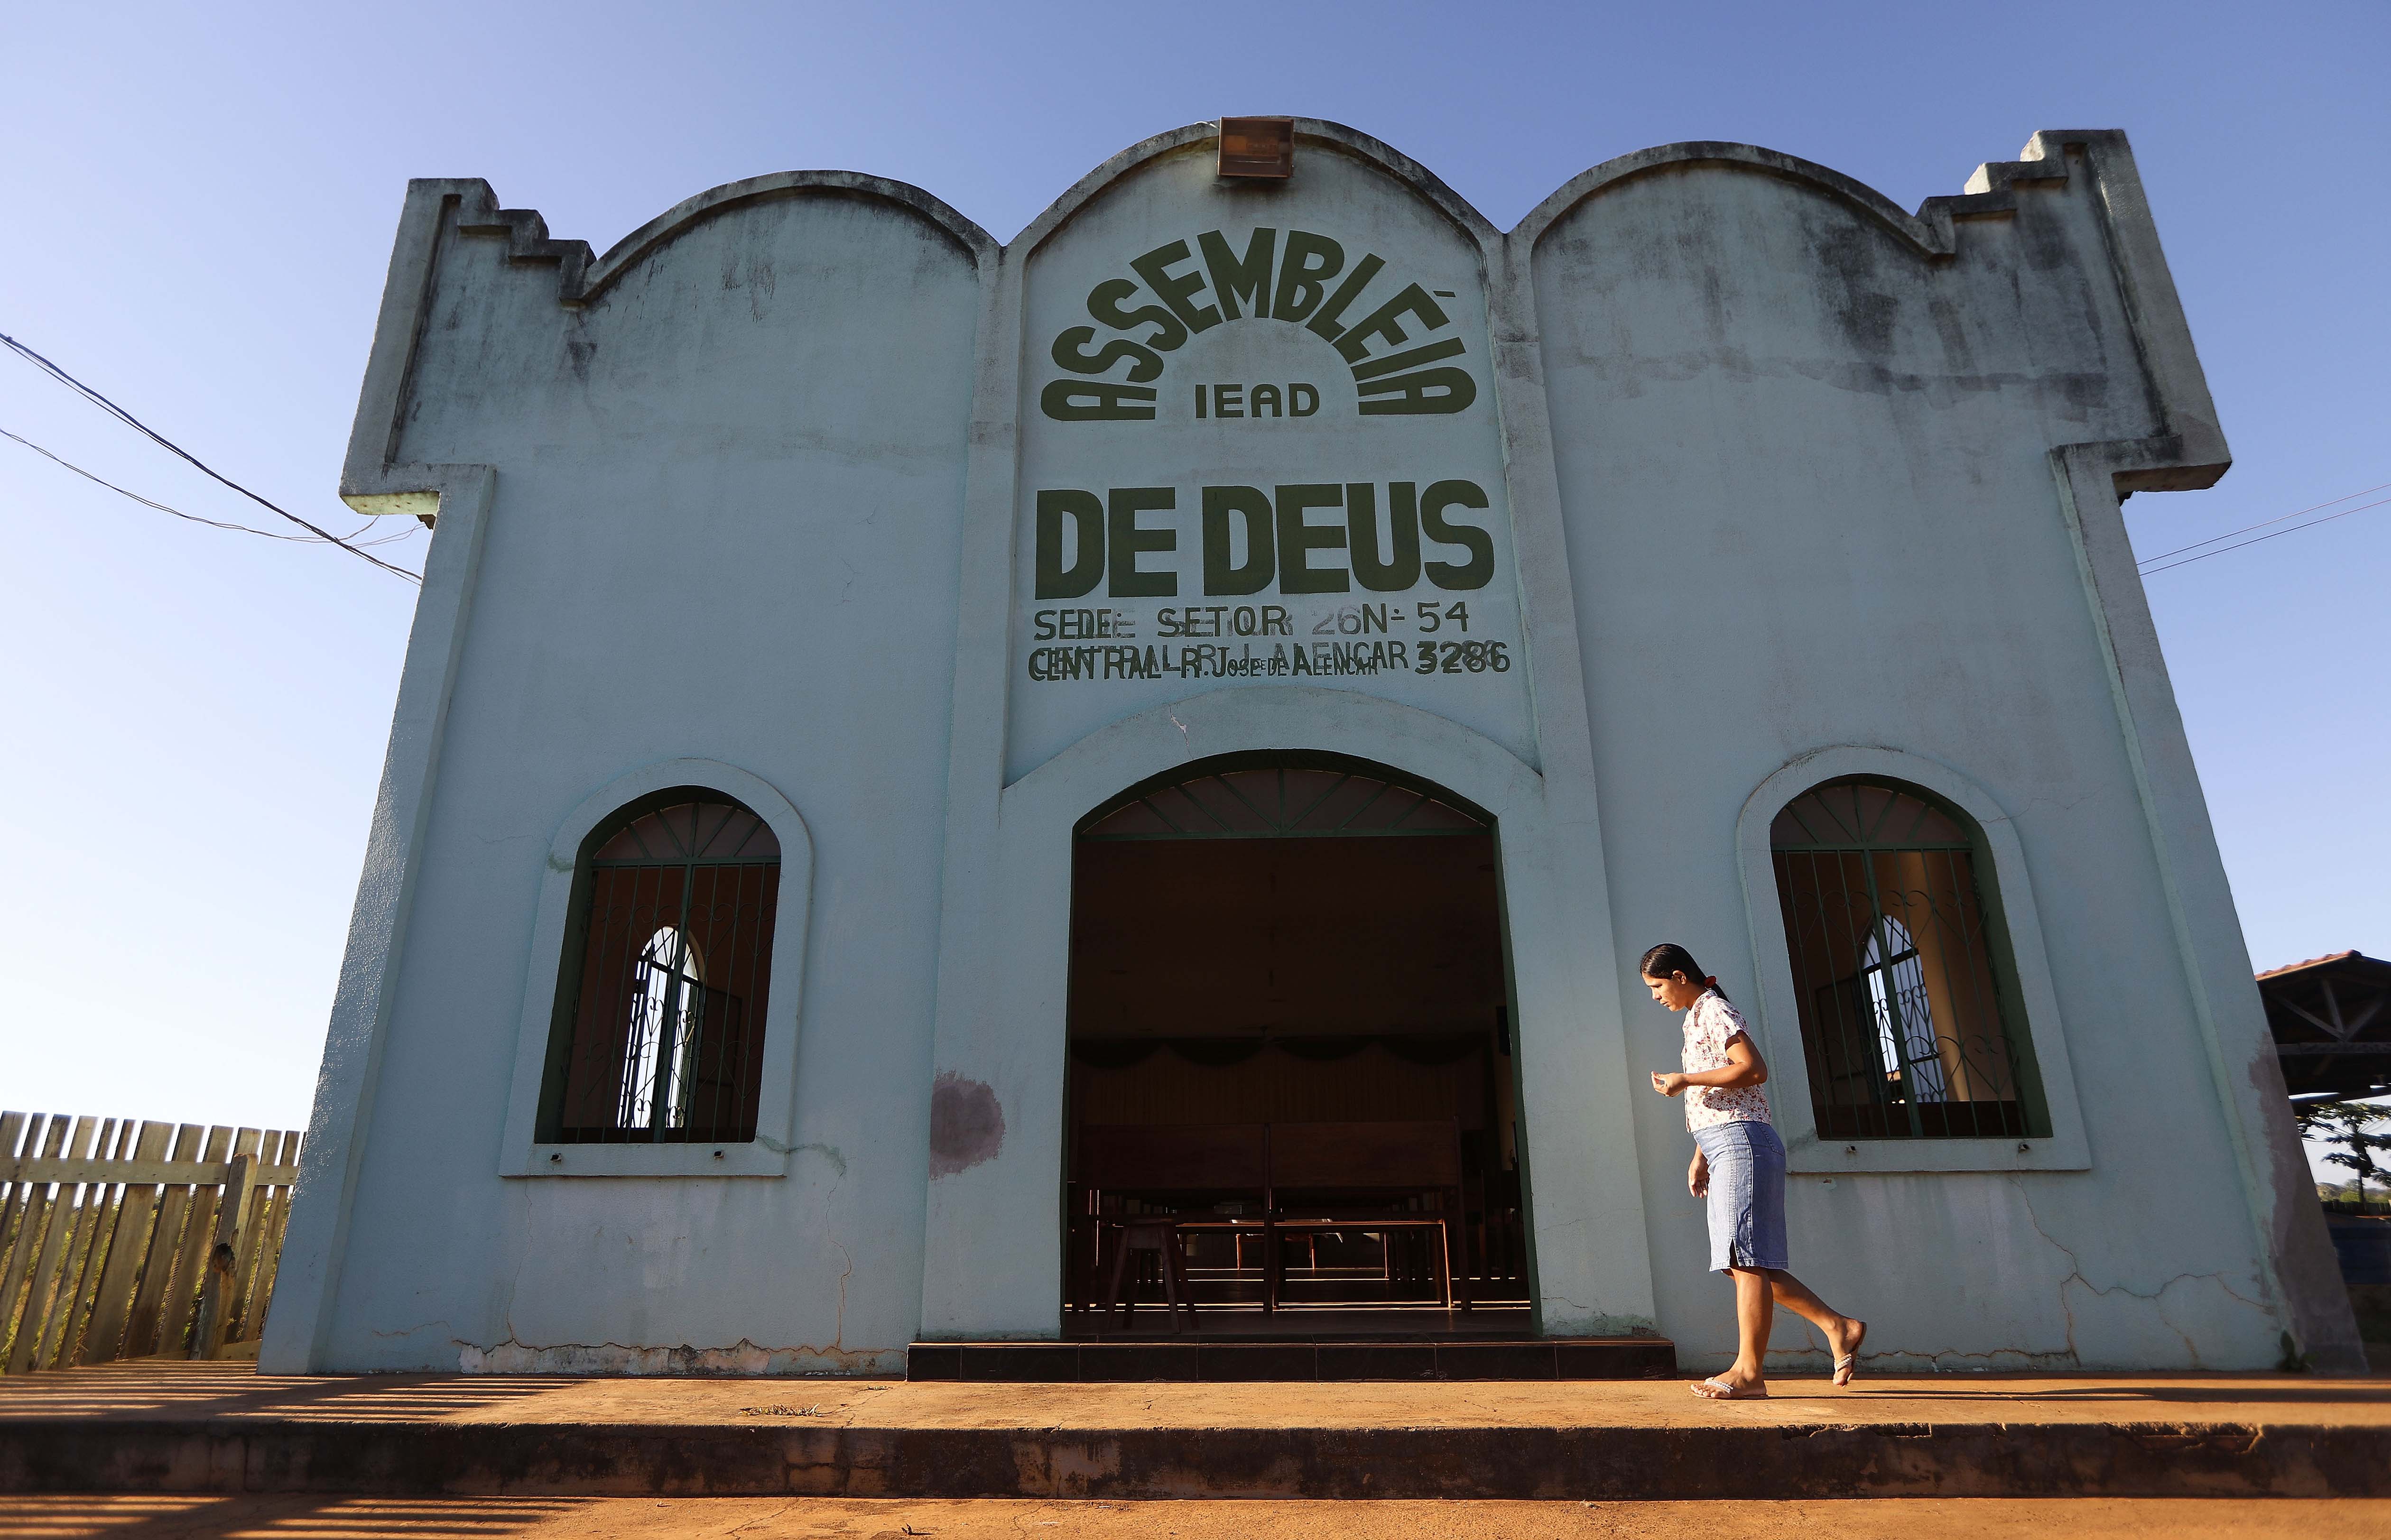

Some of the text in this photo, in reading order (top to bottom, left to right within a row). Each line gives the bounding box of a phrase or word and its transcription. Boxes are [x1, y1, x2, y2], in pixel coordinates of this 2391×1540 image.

[1195, 383, 1320, 418] IEAD
[1035, 479, 1495, 600] DE DEUS
[1157, 605, 1287, 637] SETOR
[1417, 601, 1469, 633] 54
[1029, 645, 1161, 682] CENTRAL
[1415, 641, 1511, 675] 3286
